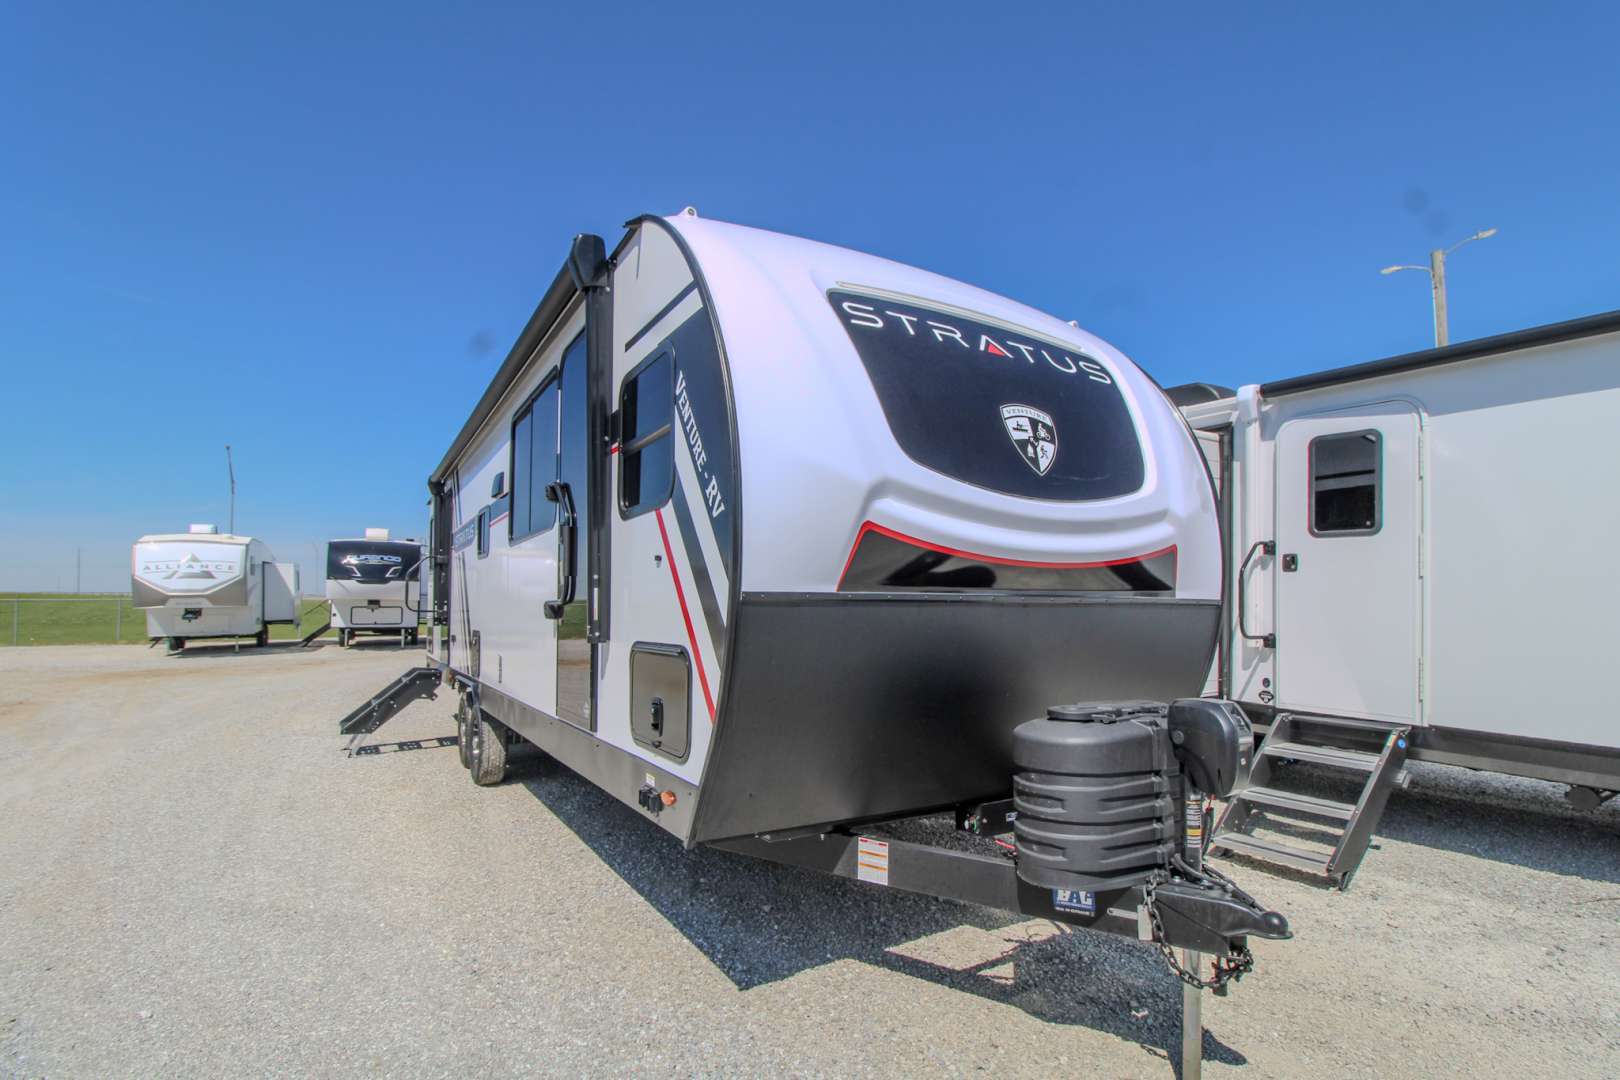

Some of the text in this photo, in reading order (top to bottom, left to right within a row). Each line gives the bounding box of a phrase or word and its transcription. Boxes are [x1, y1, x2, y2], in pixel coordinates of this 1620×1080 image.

[842, 302, 1111, 384] STRATUS
[674, 370, 707, 472] VENTURE
[706, 475, 726, 518] RV
[1005, 408, 1047, 421] VENTURE
